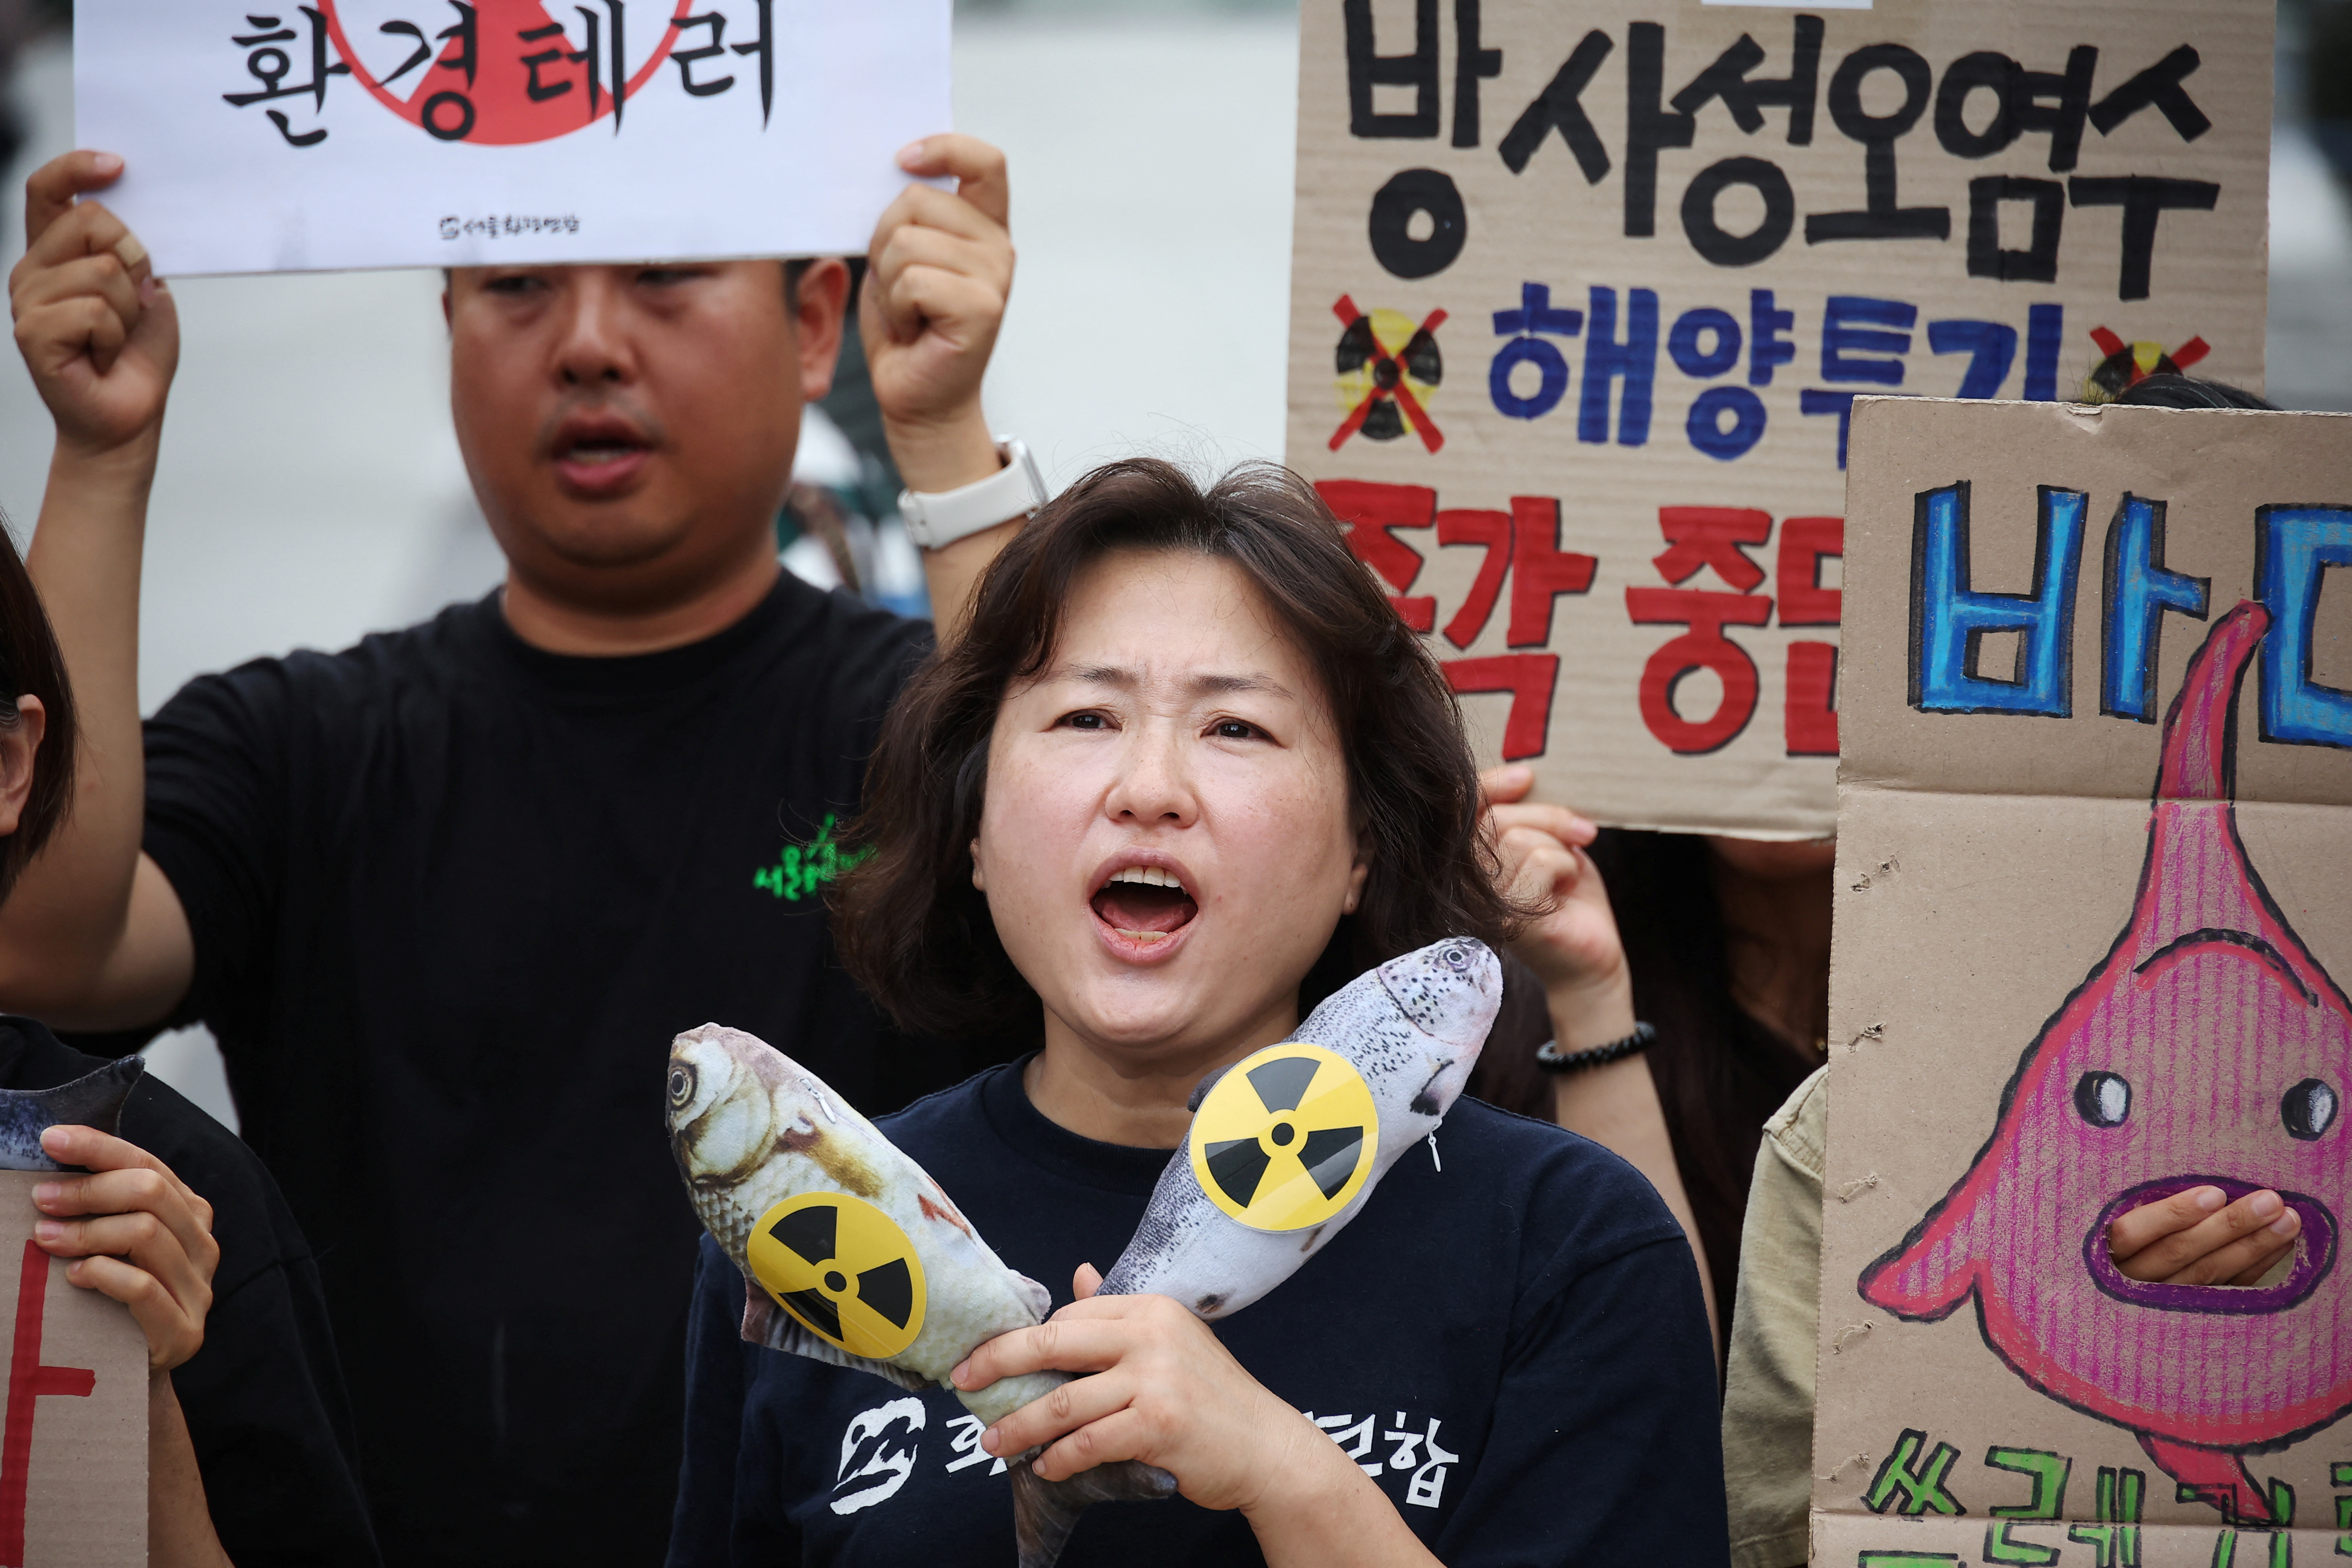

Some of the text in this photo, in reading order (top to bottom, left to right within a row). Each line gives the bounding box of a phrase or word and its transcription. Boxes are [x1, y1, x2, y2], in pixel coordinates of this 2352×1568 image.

[222, 0, 774, 147] 환경테러
[1344, 0, 2221, 300] 방사성오염수
[1489, 282, 2063, 469] 해양투기
